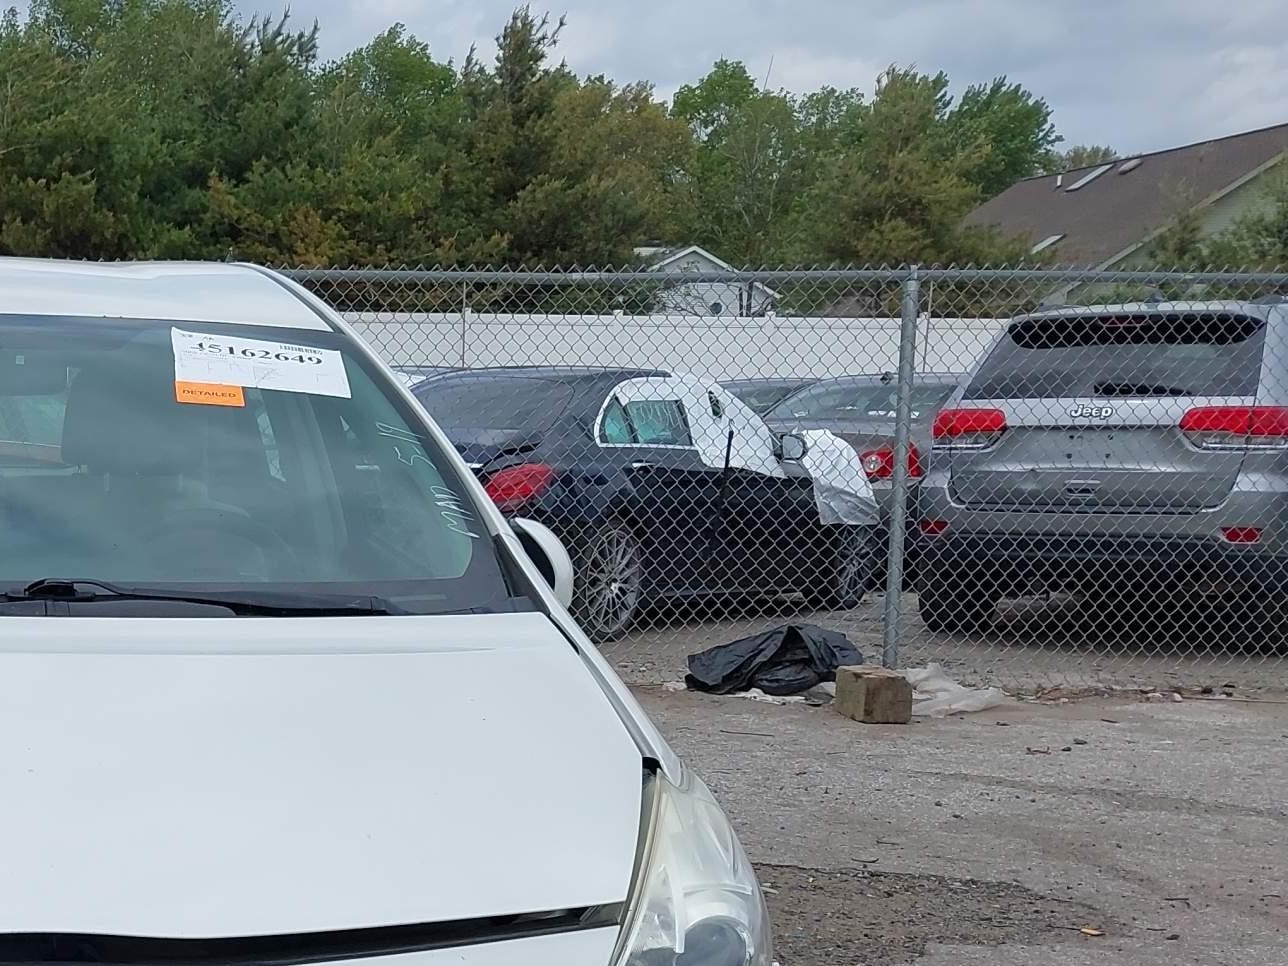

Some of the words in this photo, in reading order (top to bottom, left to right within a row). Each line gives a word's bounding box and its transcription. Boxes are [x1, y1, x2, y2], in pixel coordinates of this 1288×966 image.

[190, 341, 323, 365] 45162649
[182, 389, 237, 398] DETAILED
[1069, 403, 1114, 420] Jeep
